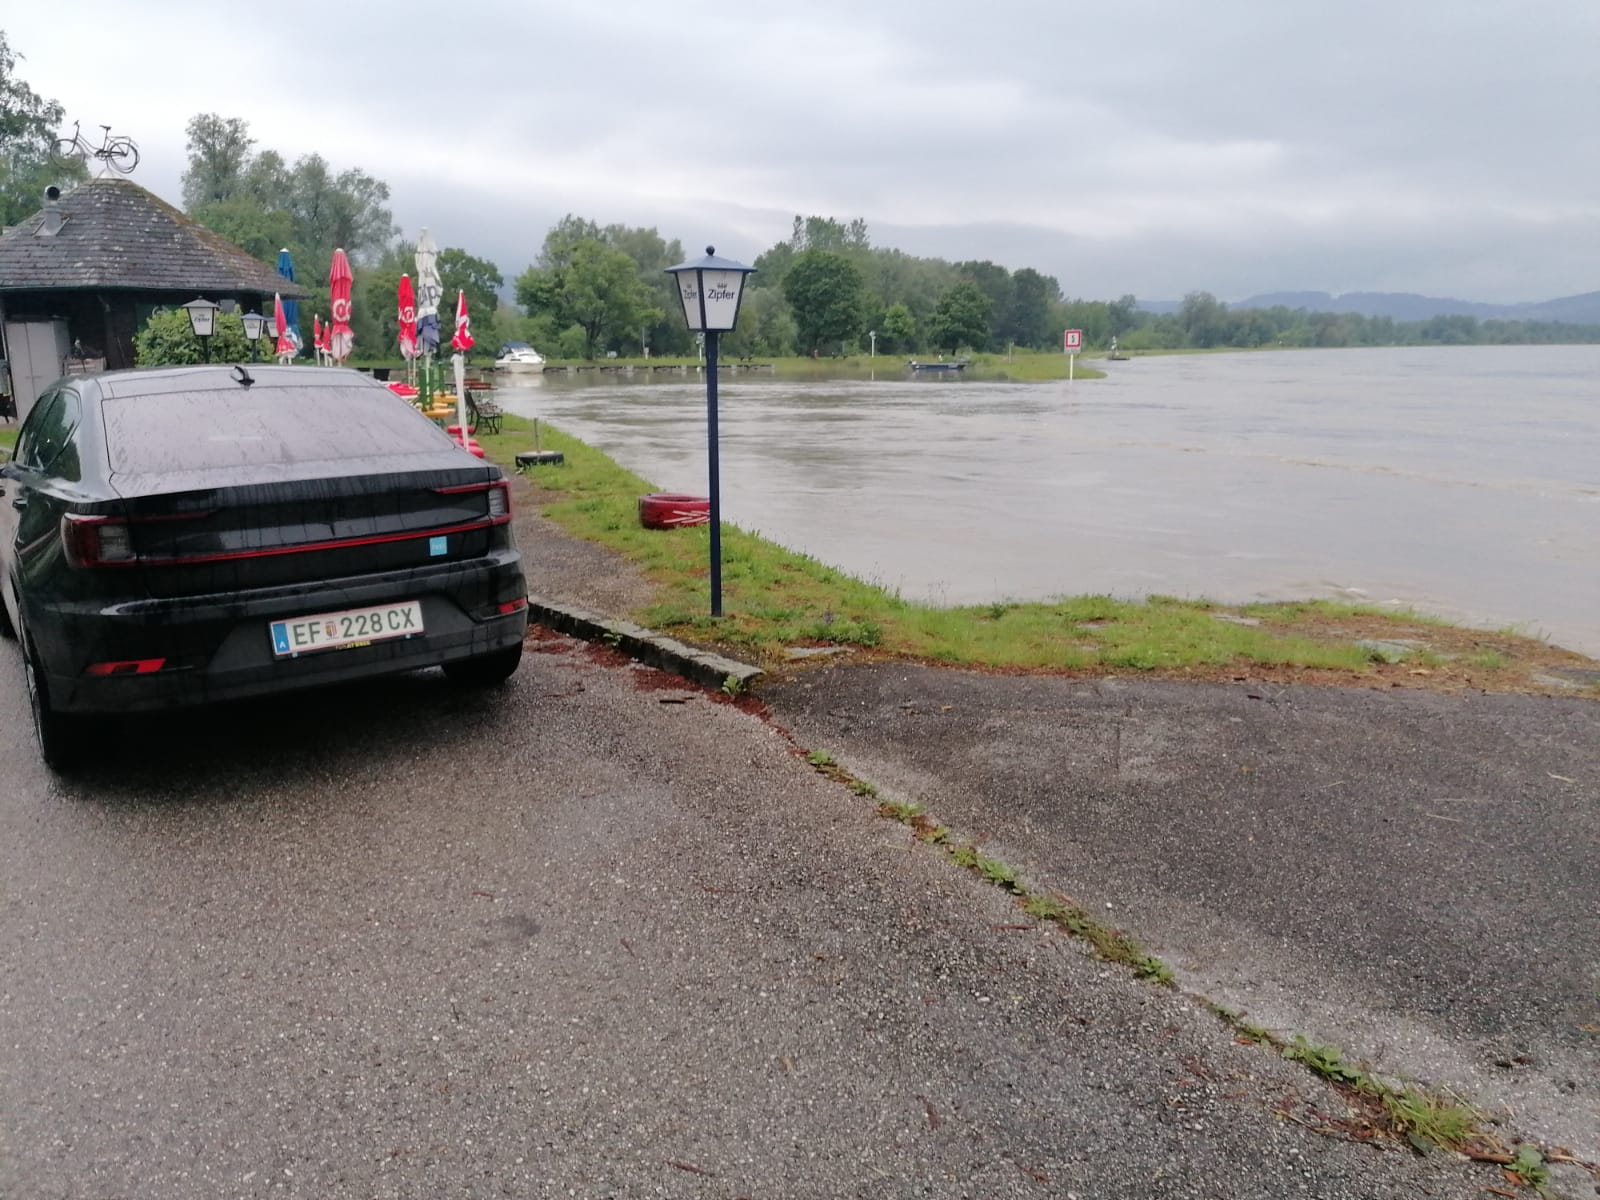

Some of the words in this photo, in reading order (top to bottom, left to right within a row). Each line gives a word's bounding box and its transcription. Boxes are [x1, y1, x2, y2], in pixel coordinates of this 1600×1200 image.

[707, 288, 736, 302] Zipfer
[292, 621, 321, 646] EF
[340, 613, 383, 639] 228
[387, 607, 415, 631] CX
[279, 641, 286, 649] A
